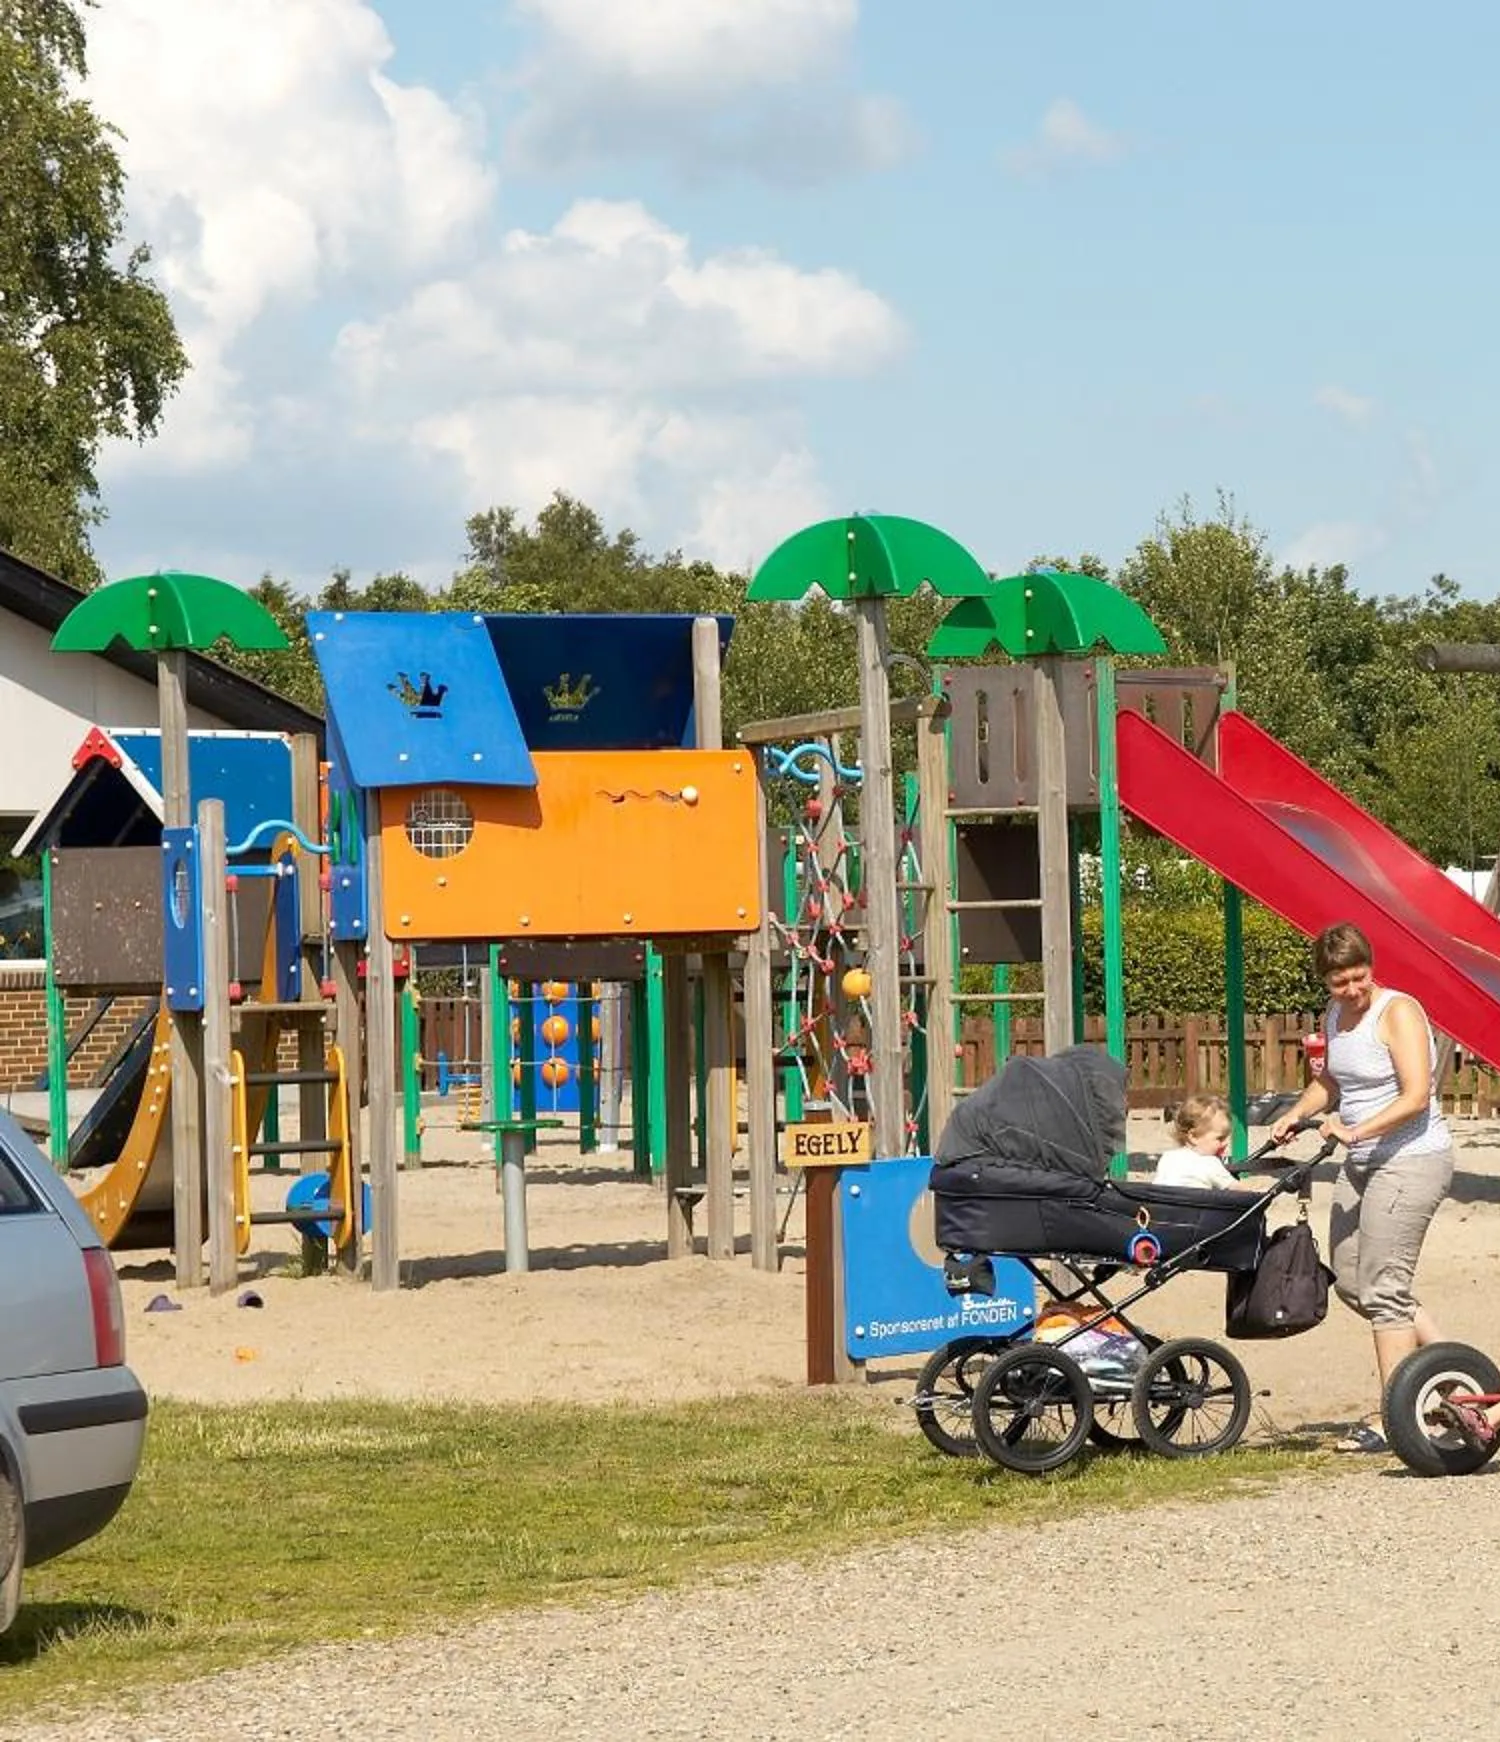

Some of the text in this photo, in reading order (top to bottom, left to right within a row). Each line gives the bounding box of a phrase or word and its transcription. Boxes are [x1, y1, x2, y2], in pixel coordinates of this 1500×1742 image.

[795, 1128, 862, 1156] EGELY
[869, 1306, 1017, 1338] Sponsoreret af FONDEN
